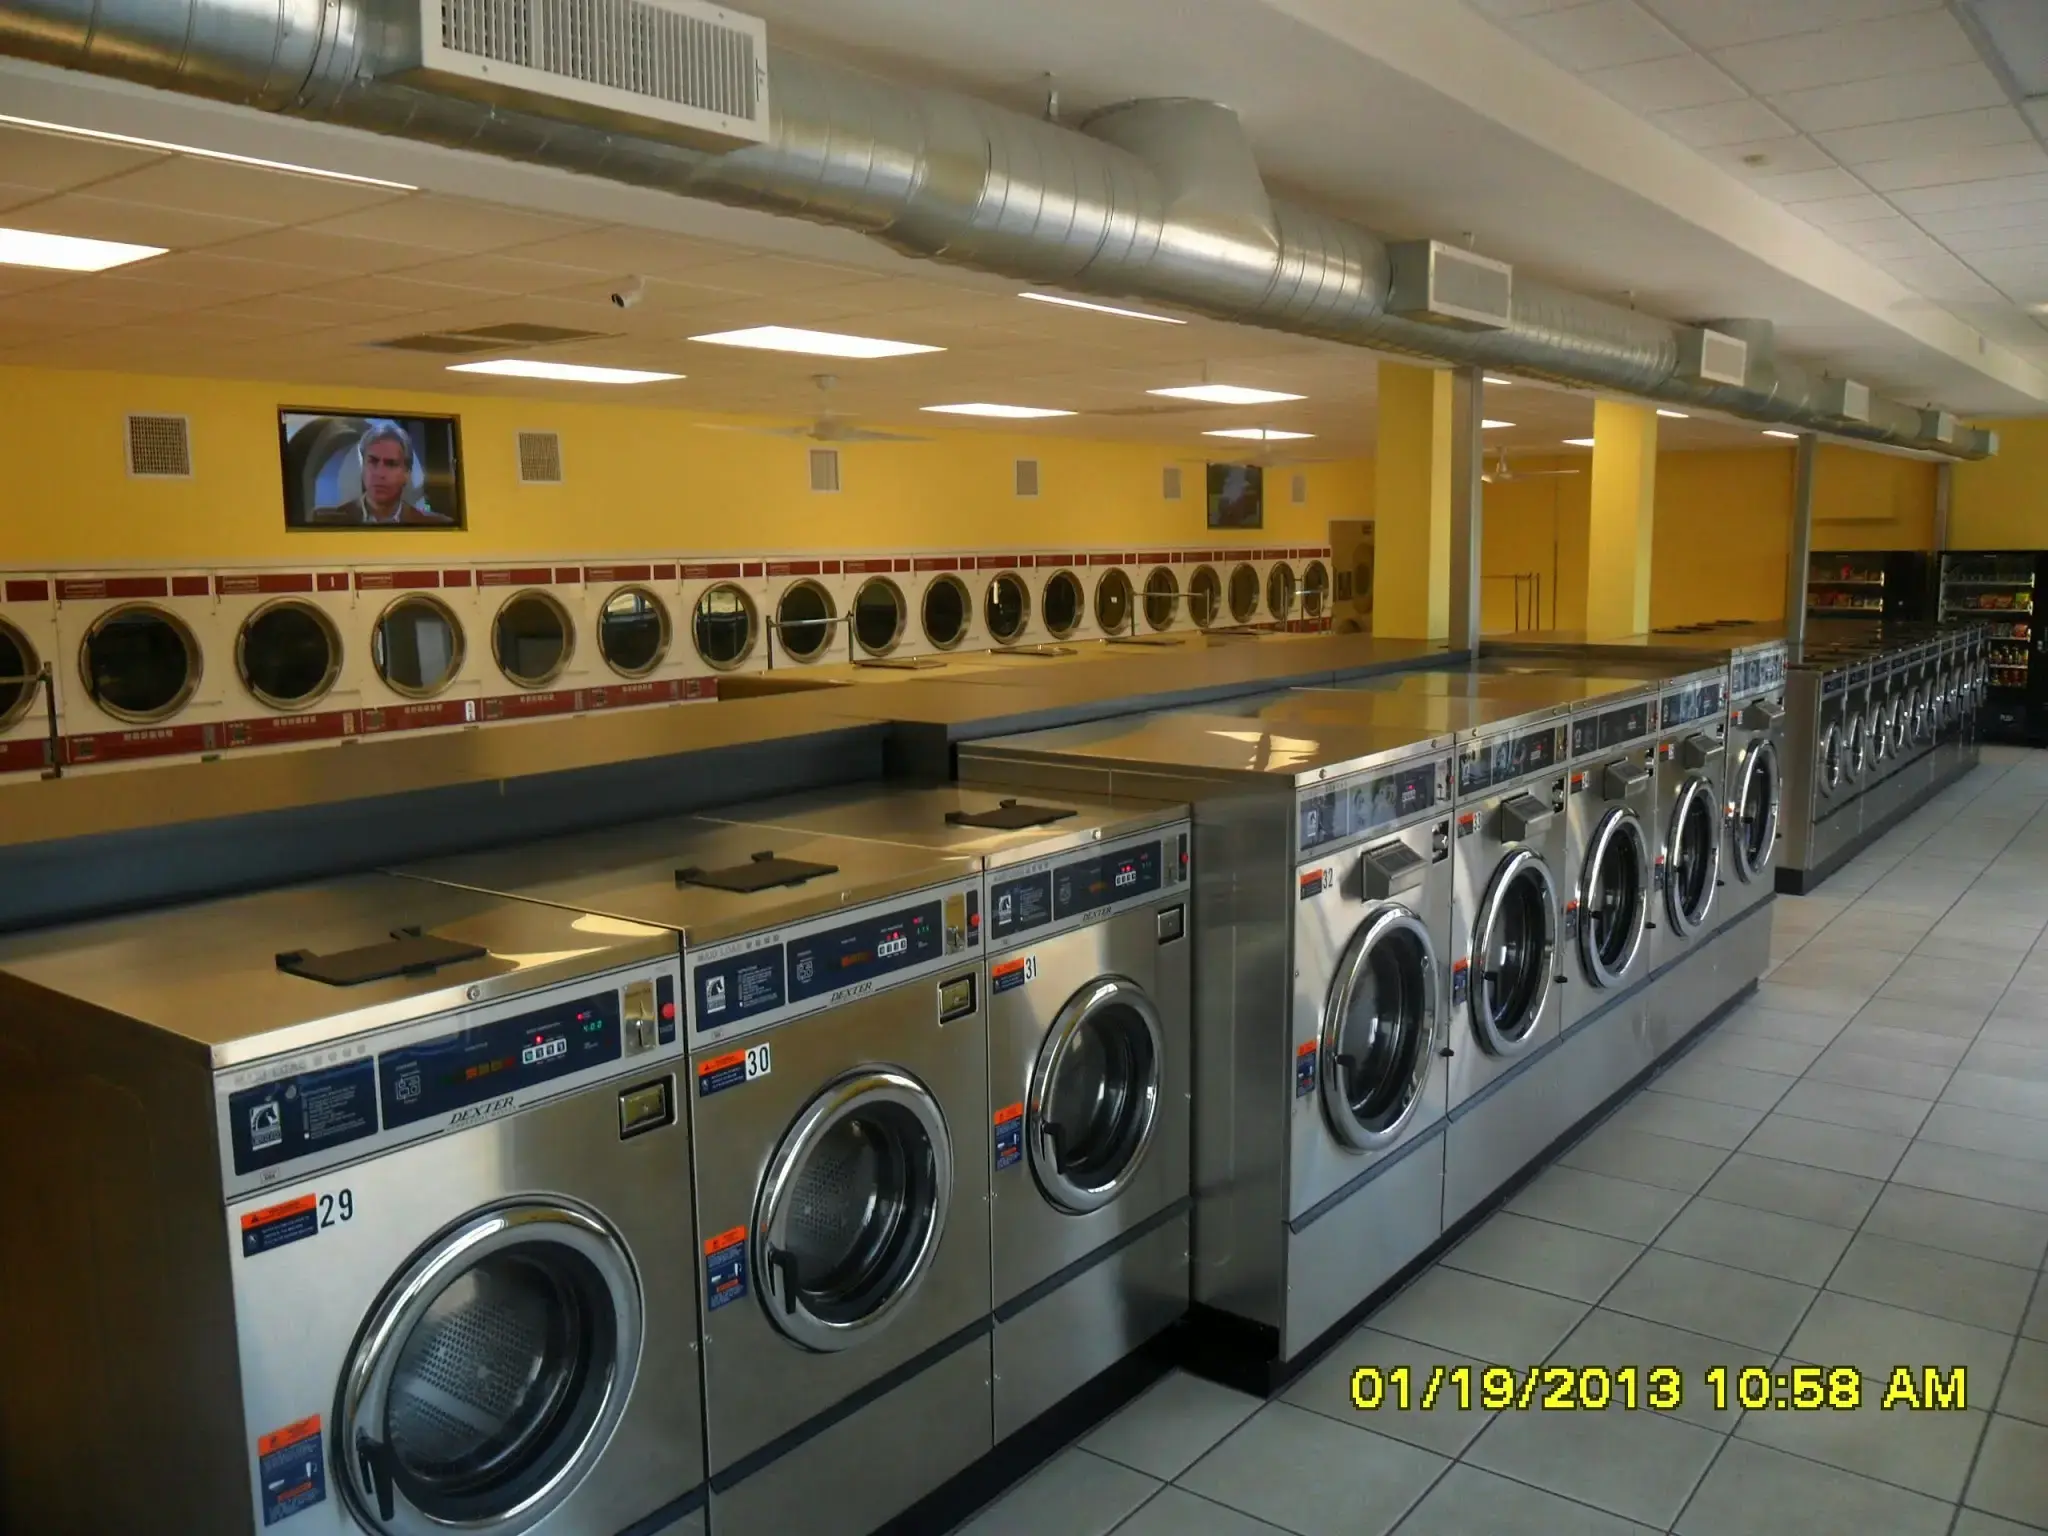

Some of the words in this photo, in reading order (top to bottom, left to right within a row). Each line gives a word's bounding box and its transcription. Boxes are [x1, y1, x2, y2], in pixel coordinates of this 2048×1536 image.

[1323, 867, 1334, 889] 32
[1025, 955, 1037, 979] 31
[831, 981, 873, 1002] DEXTER
[747, 1046, 770, 1077] 30
[449, 1095, 515, 1125] DEXTER
[319, 1187, 354, 1229] 29
